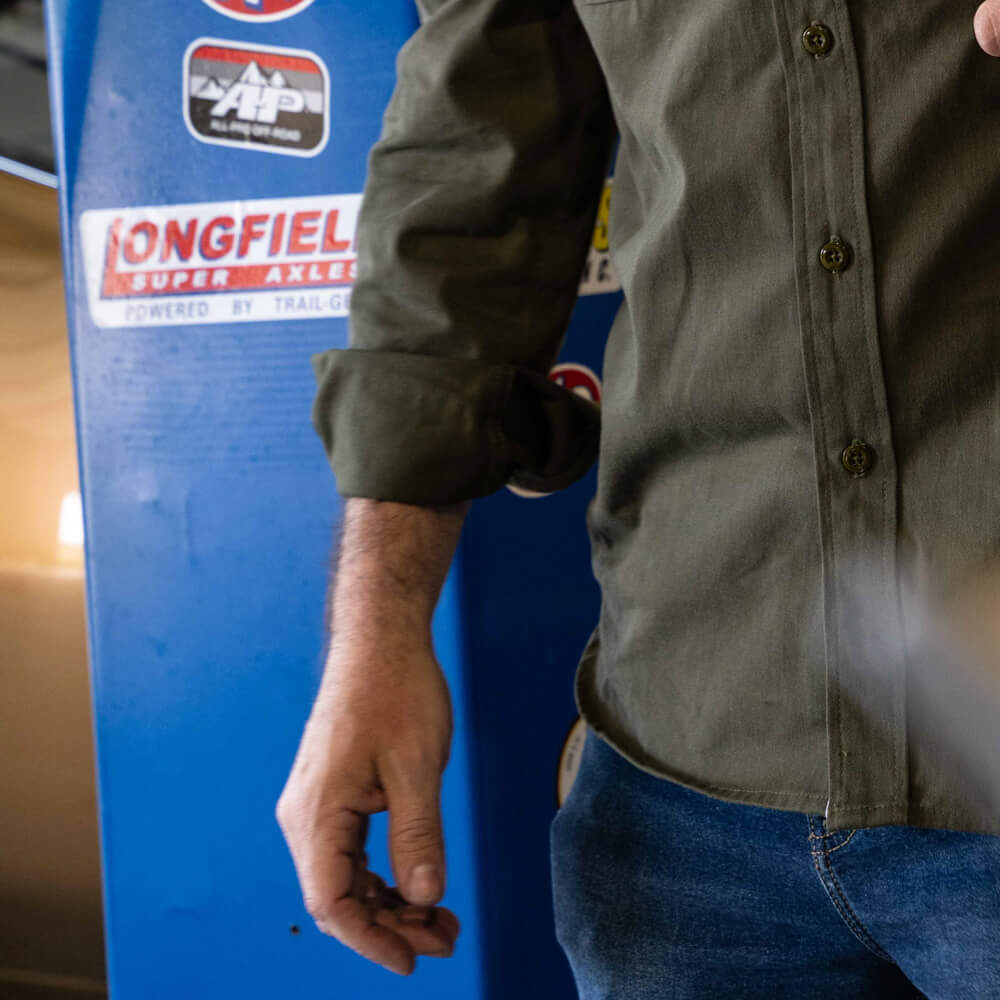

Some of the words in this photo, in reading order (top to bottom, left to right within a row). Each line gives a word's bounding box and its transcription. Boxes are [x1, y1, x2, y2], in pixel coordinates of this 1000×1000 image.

[102, 209, 357, 296] LONGFIEL
[131, 269, 230, 291] SUPER
[125, 301, 209, 321] POWERED
[232, 299, 253, 316] BY
